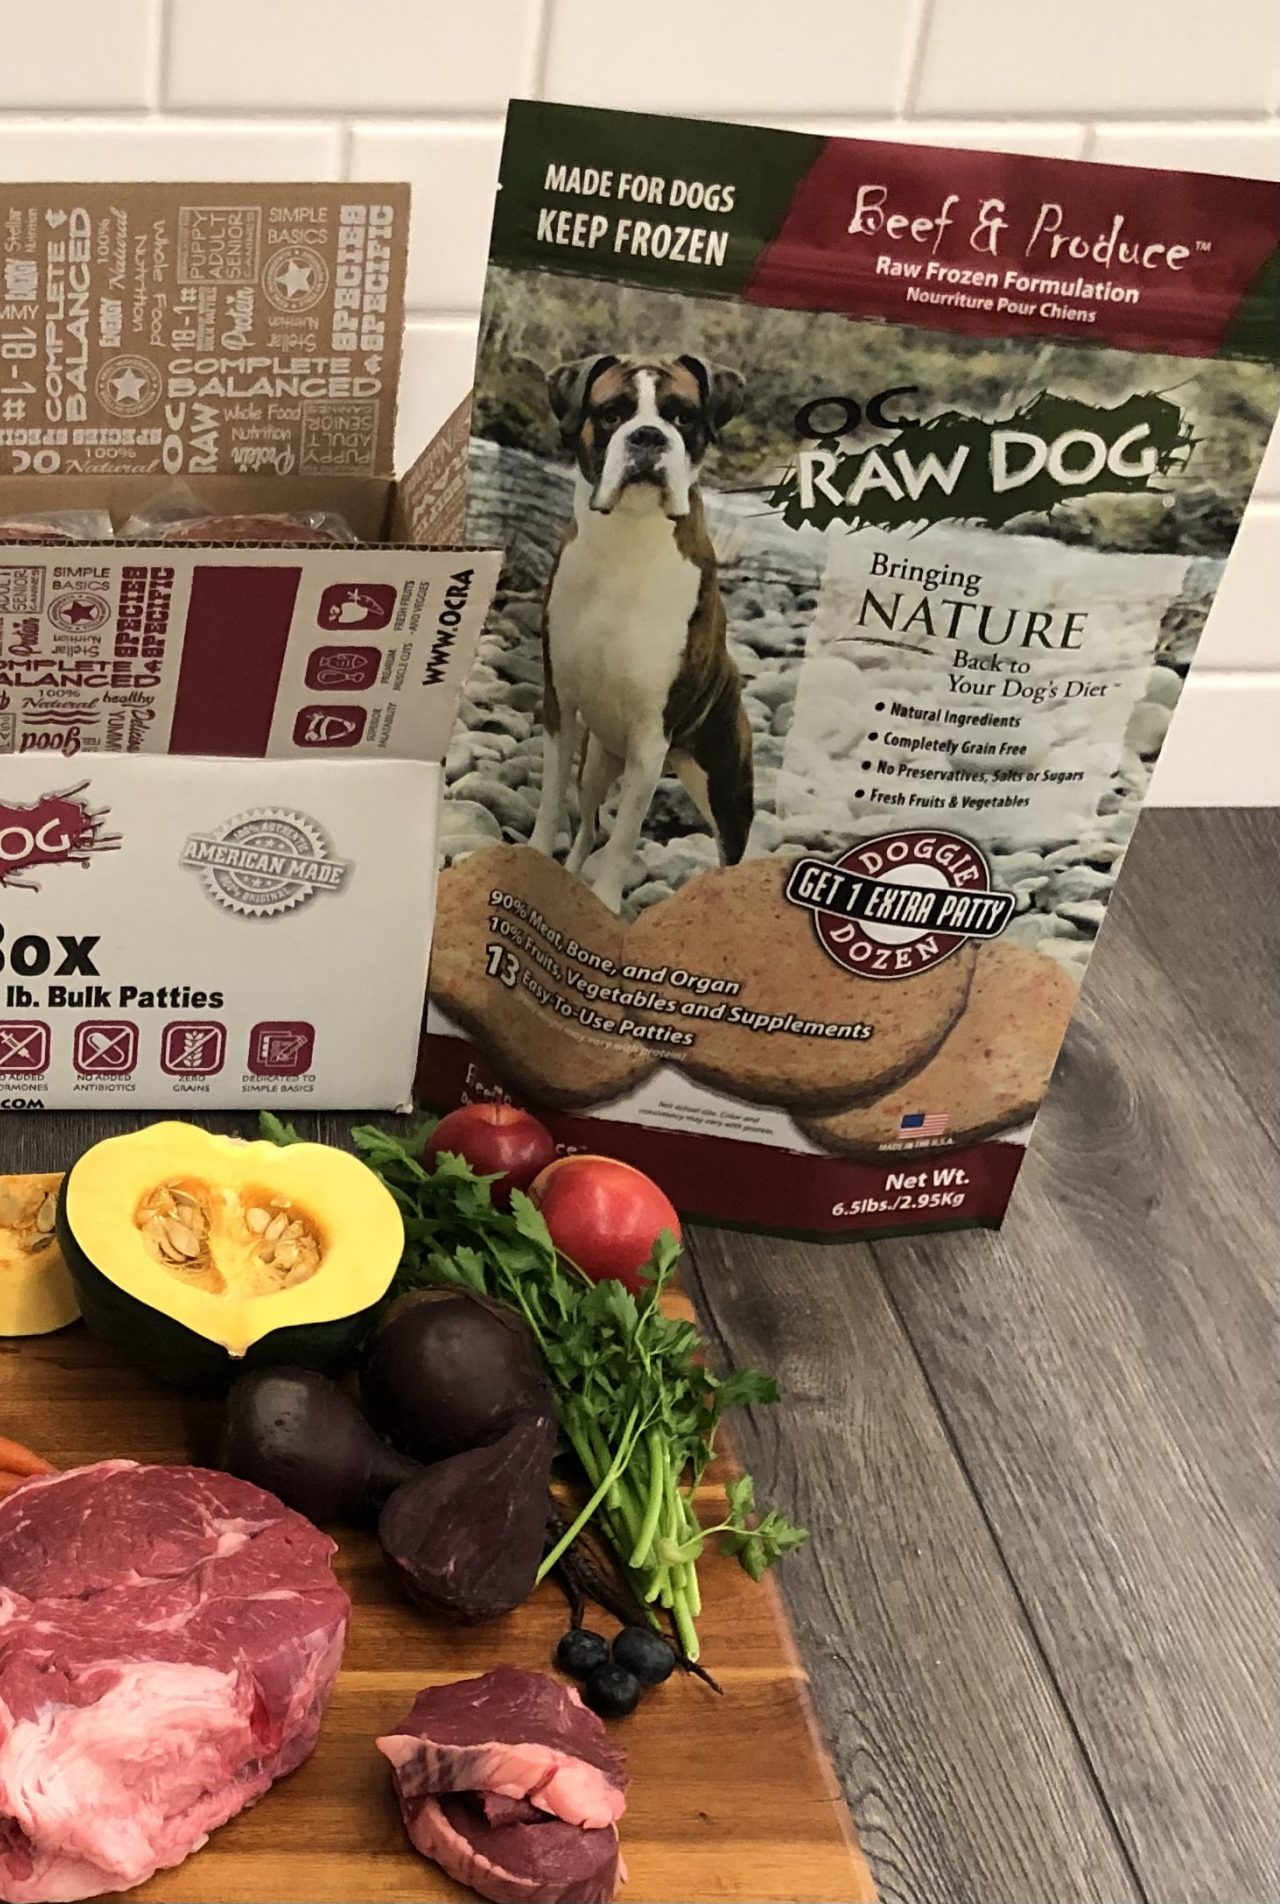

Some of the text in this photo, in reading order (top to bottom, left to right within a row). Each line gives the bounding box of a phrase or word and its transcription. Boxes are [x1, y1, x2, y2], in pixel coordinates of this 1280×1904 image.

[544, 163, 737, 213] MADE FOR DOGS
[269, 208, 328, 223] SIMPLE
[848, 184, 959, 254] Beef
[969, 198, 1007, 256] &
[269, 229, 328, 244] BASICS
[536, 208, 729, 267] KEEP FROZEN
[875, 255, 1140, 305] Raw Frozen Formulation
[906, 287, 1097, 324] Nourriture Pour Chiens
[169, 357, 352, 375] COMPLETE
[168, 377, 382, 398] BALANCED
[794, 386, 923, 441] OC
[797, 421, 1158, 512] RAW DOG
[53, 566, 111, 578] SIMPLE
[53, 580, 110, 591] BASICS
[869, 551, 983, 596] Bringing
[855, 588, 1089, 650] NATURE
[951, 648, 1031, 675] Back to
[948, 674, 996, 698] Your
[1002, 678, 1059, 705] Dog's
[890, 702, 1022, 730] Natural Ingredients
[883, 731, 1027, 757] Completely Grain Free
[876, 760, 1085, 785] No Preservatives, Salts or Sugars
[870, 788, 1031, 811] Fresh Fruits & Vegetables
[184, 840, 344, 884] AMERICAN MADE
[858, 837, 980, 888] DOGGIE
[798, 866, 1006, 930] GET 1 EXTRA PATTY
[489, 890, 740, 997] 90% Meat, Bone, and Organ
[829, 923, 940, 970] DOZEN
[488, 915, 873, 1041] 10% Fruits, Vegetables and Supplements
[6, 985, 40, 1008] lb.
[47, 985, 111, 1009] Bulk
[118, 985, 224, 1009] Patties
[486, 944, 520, 990] 13
[521, 968, 616, 1036] Easy-To-Use
[618, 1019, 695, 1047] Patties
[9, 1073, 45, 1082] ADDED
[73, 1083, 137, 1093] ANTIBIOTICS
[77, 1074, 93, 1082] NO
[173, 1084, 210, 1093] GRAINS
[242, 1084, 315, 1093] SIMPLE BASICS
[301, 1074, 317, 1083] TO
[885, 1168, 970, 1192] Net Wt.
